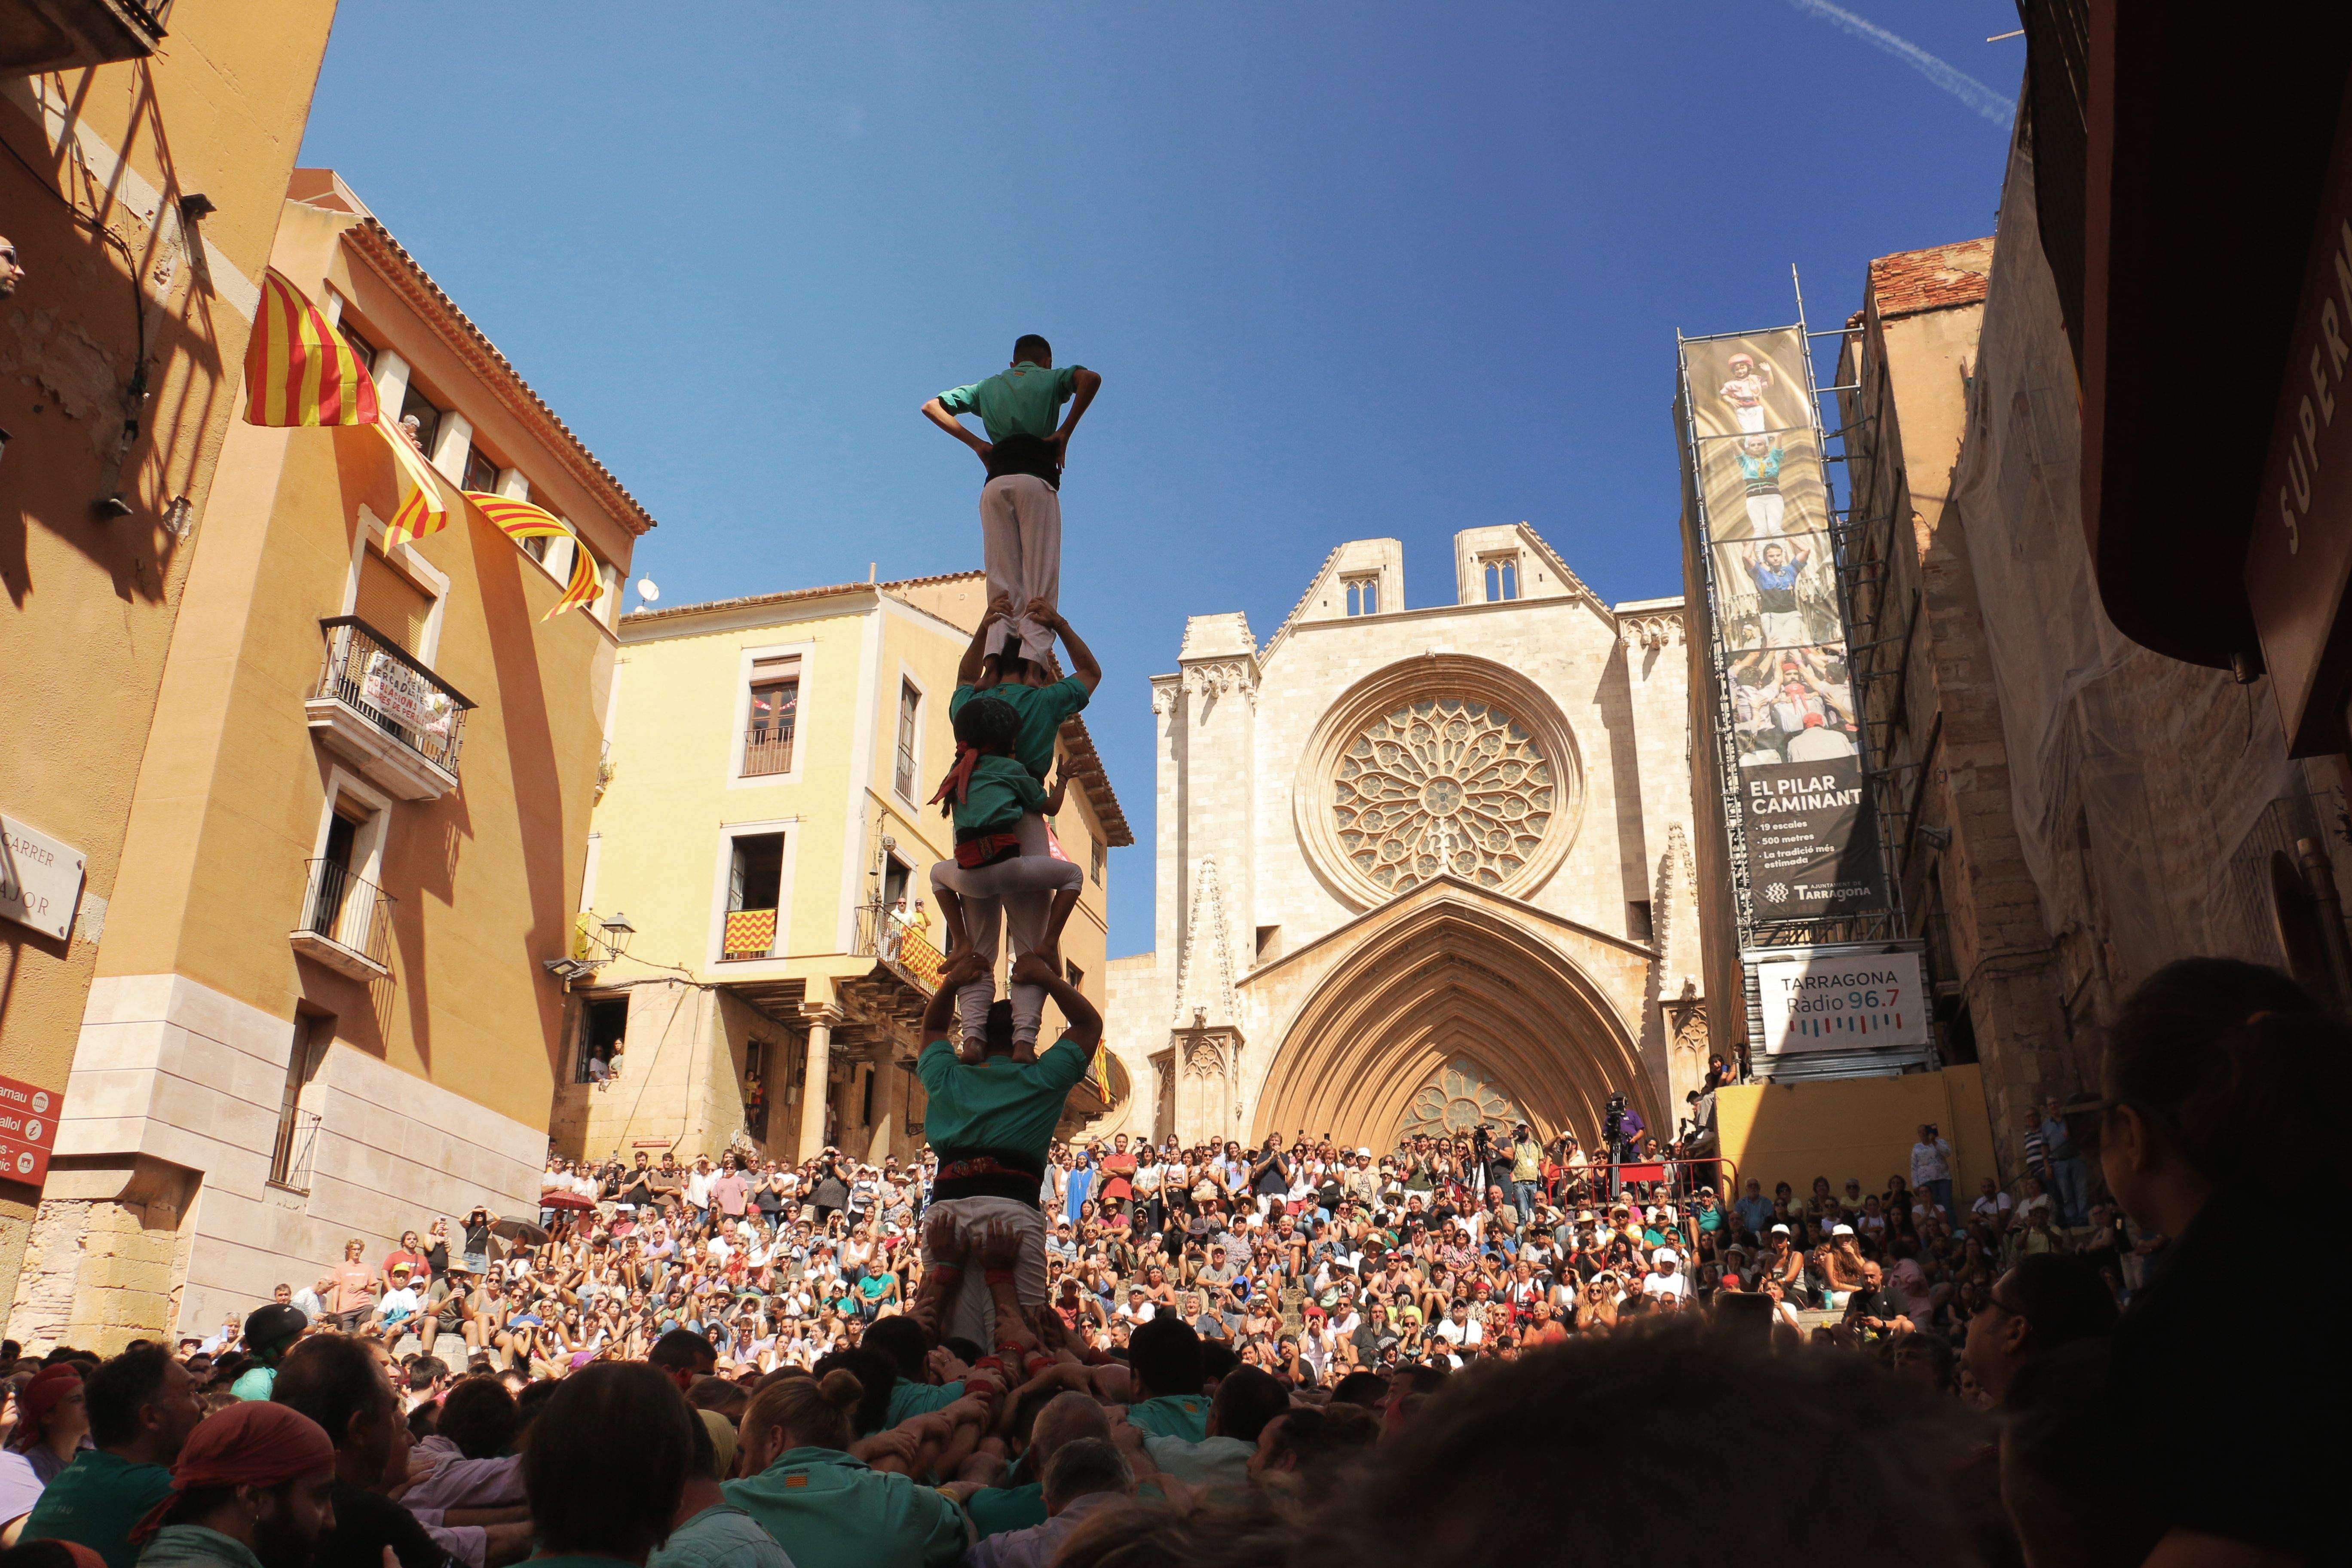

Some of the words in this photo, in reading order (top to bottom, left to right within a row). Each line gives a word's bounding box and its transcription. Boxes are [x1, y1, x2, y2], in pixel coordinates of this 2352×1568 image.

[1750, 781, 1774, 796] EL
[1777, 775, 1836, 795] PILAR
[1752, 788, 1862, 815] CAMINANT
[1772, 821, 1807, 830] escales
[1762, 836, 1779, 845] 500
[1782, 833, 1814, 843] metres
[2, 833, 55, 867] CARRER
[1776, 845, 1814, 858] tradició
[1816, 844, 1835, 853] més
[1764, 857, 1808, 869] estimada
[1781, 971, 1899, 991] TARRAGONA
[1787, 994, 1844, 1014] Ràdio
[1848, 989, 1900, 1009] 96.7
